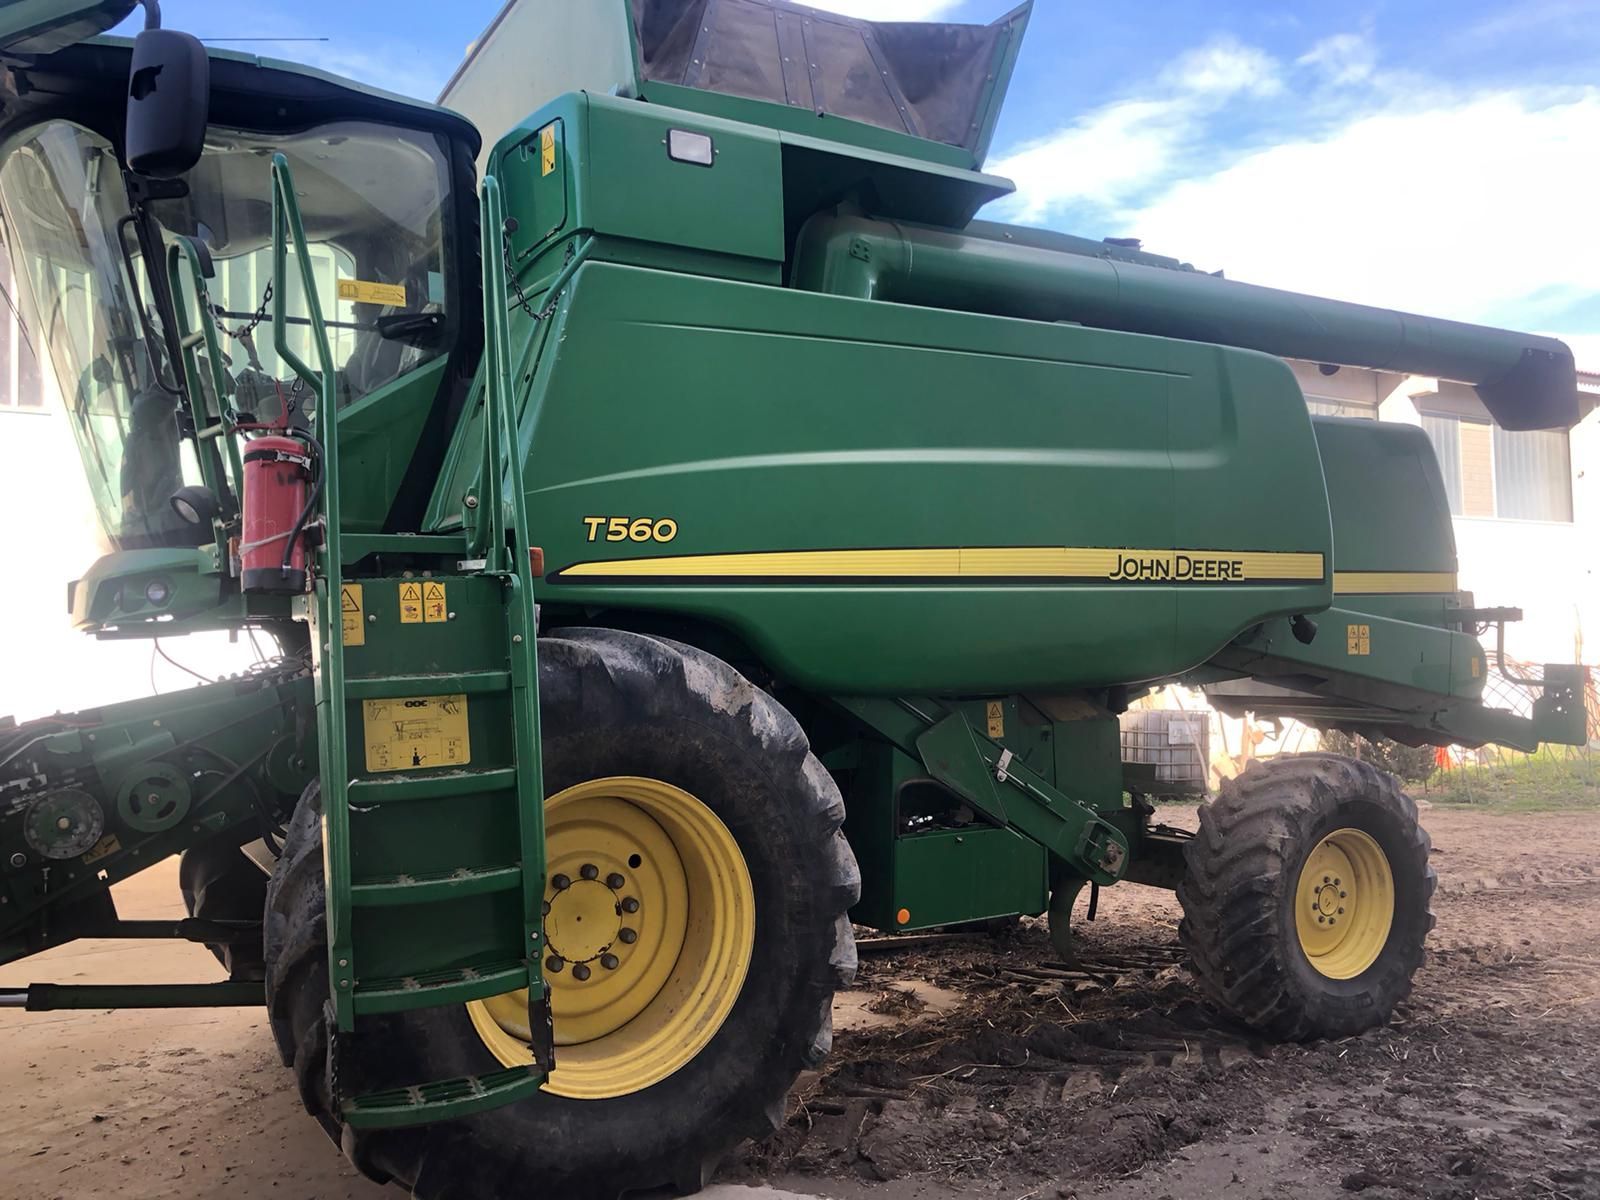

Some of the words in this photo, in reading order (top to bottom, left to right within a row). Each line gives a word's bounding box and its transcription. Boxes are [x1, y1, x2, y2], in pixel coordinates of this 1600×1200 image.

[583, 516, 678, 543] T560
[1109, 554, 1170, 578] JOHN
[1175, 555, 1244, 579] DEERE
